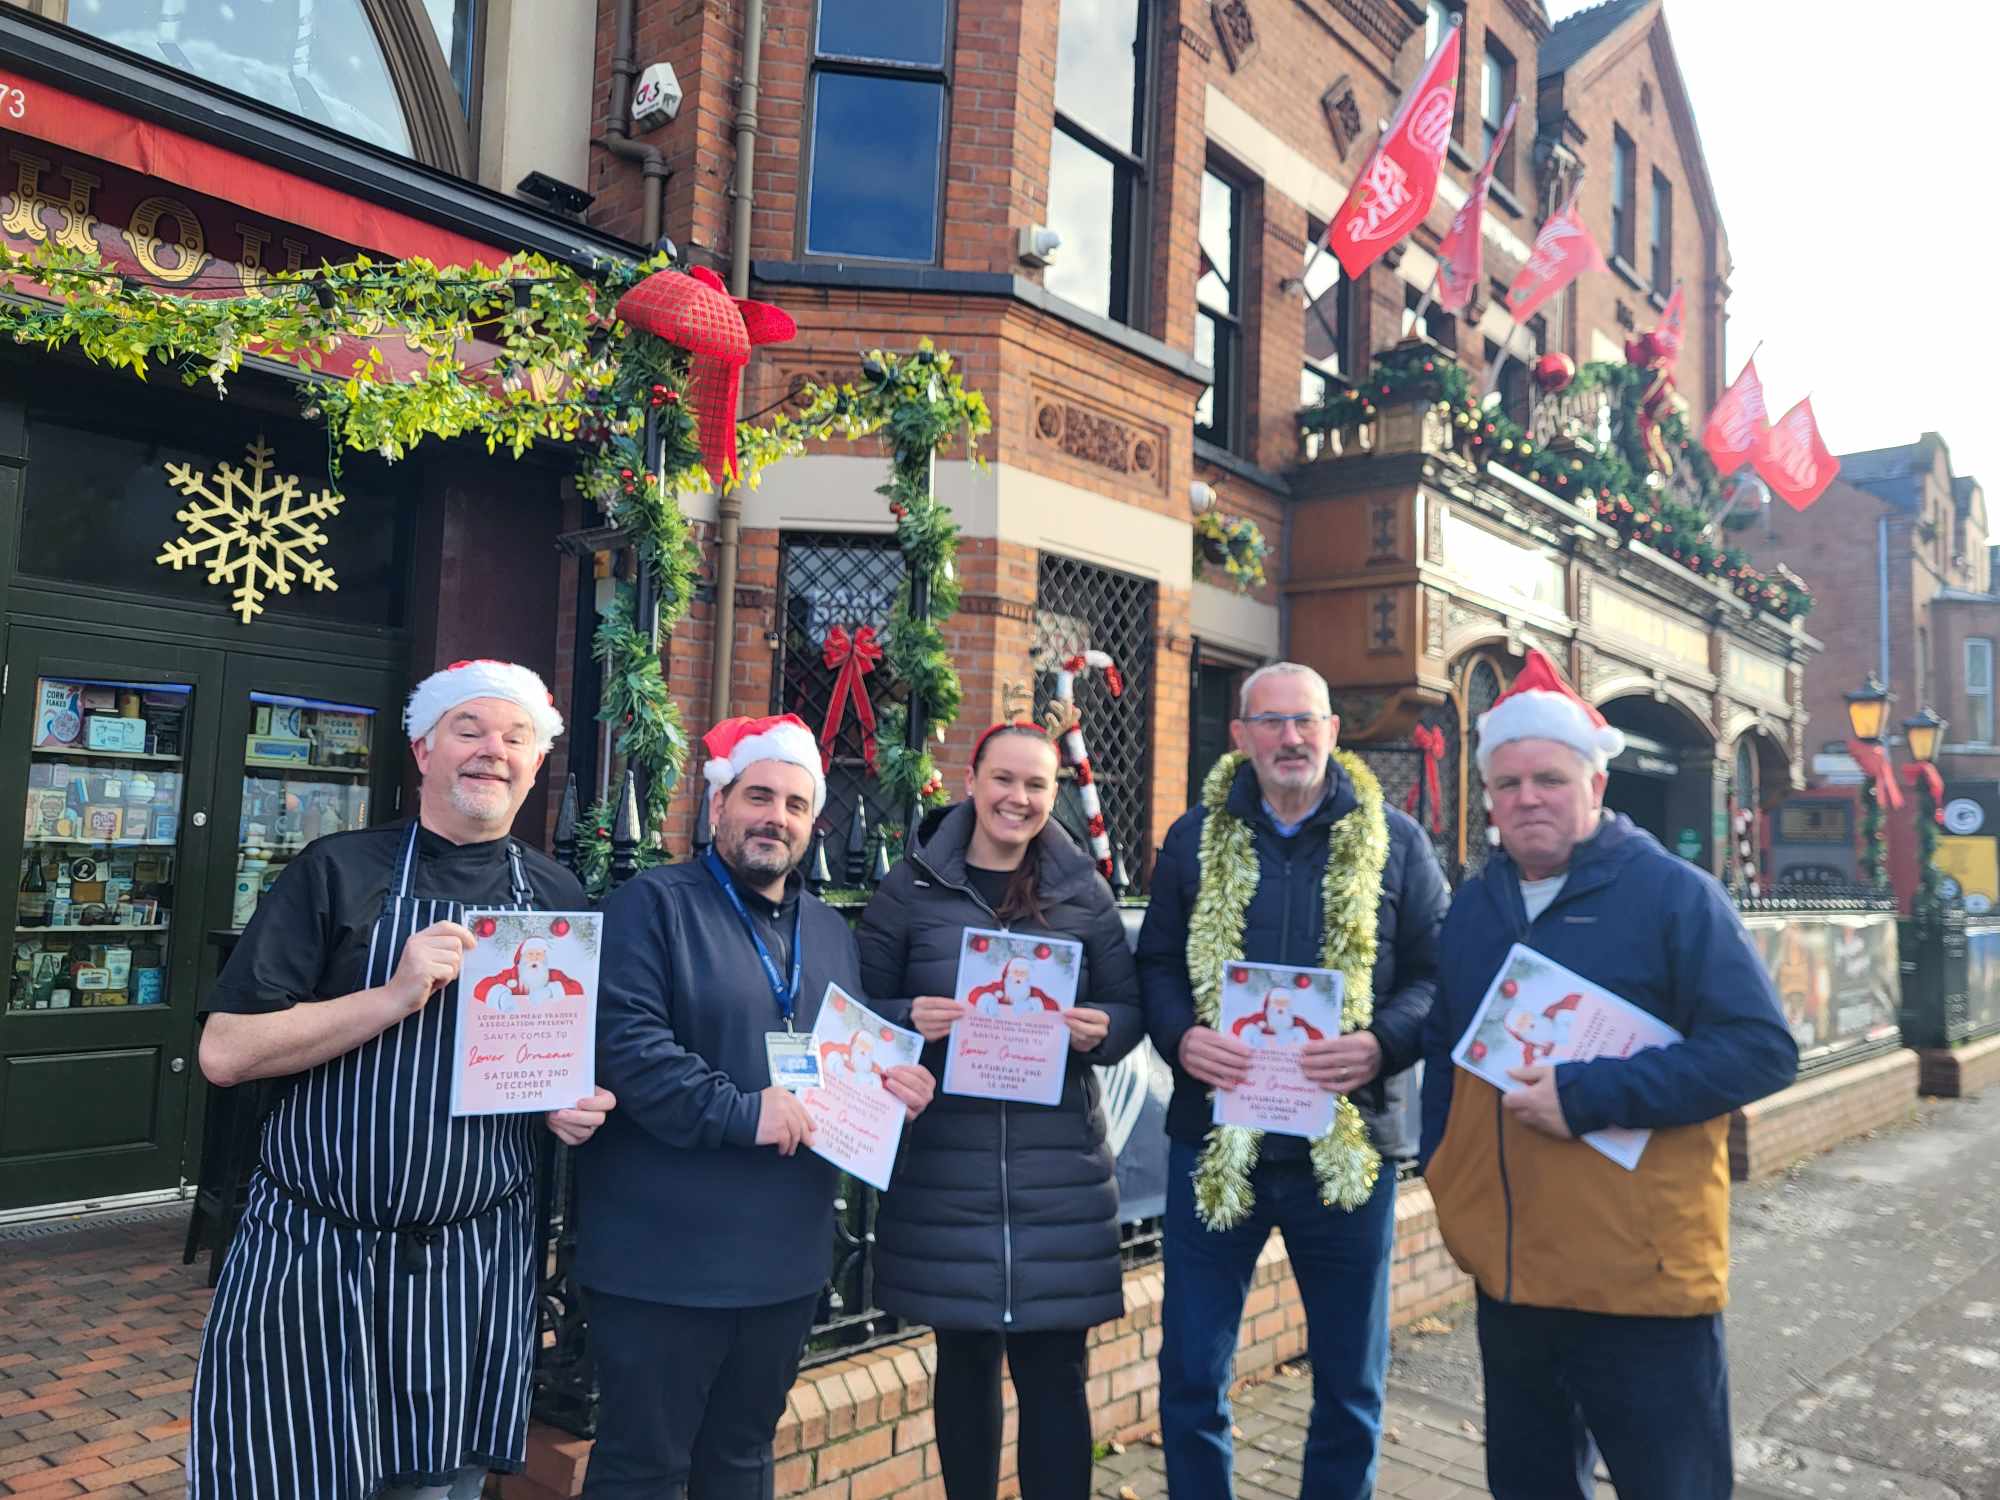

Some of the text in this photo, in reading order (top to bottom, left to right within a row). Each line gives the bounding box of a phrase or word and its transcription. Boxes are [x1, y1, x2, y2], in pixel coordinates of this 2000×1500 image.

[483, 1032, 517, 1040] SANTA
[484, 1069, 569, 1080] SATURDAY 2ND
[496, 1080, 552, 1090] DECEMBER
[505, 1091, 543, 1100] 12-3PM
